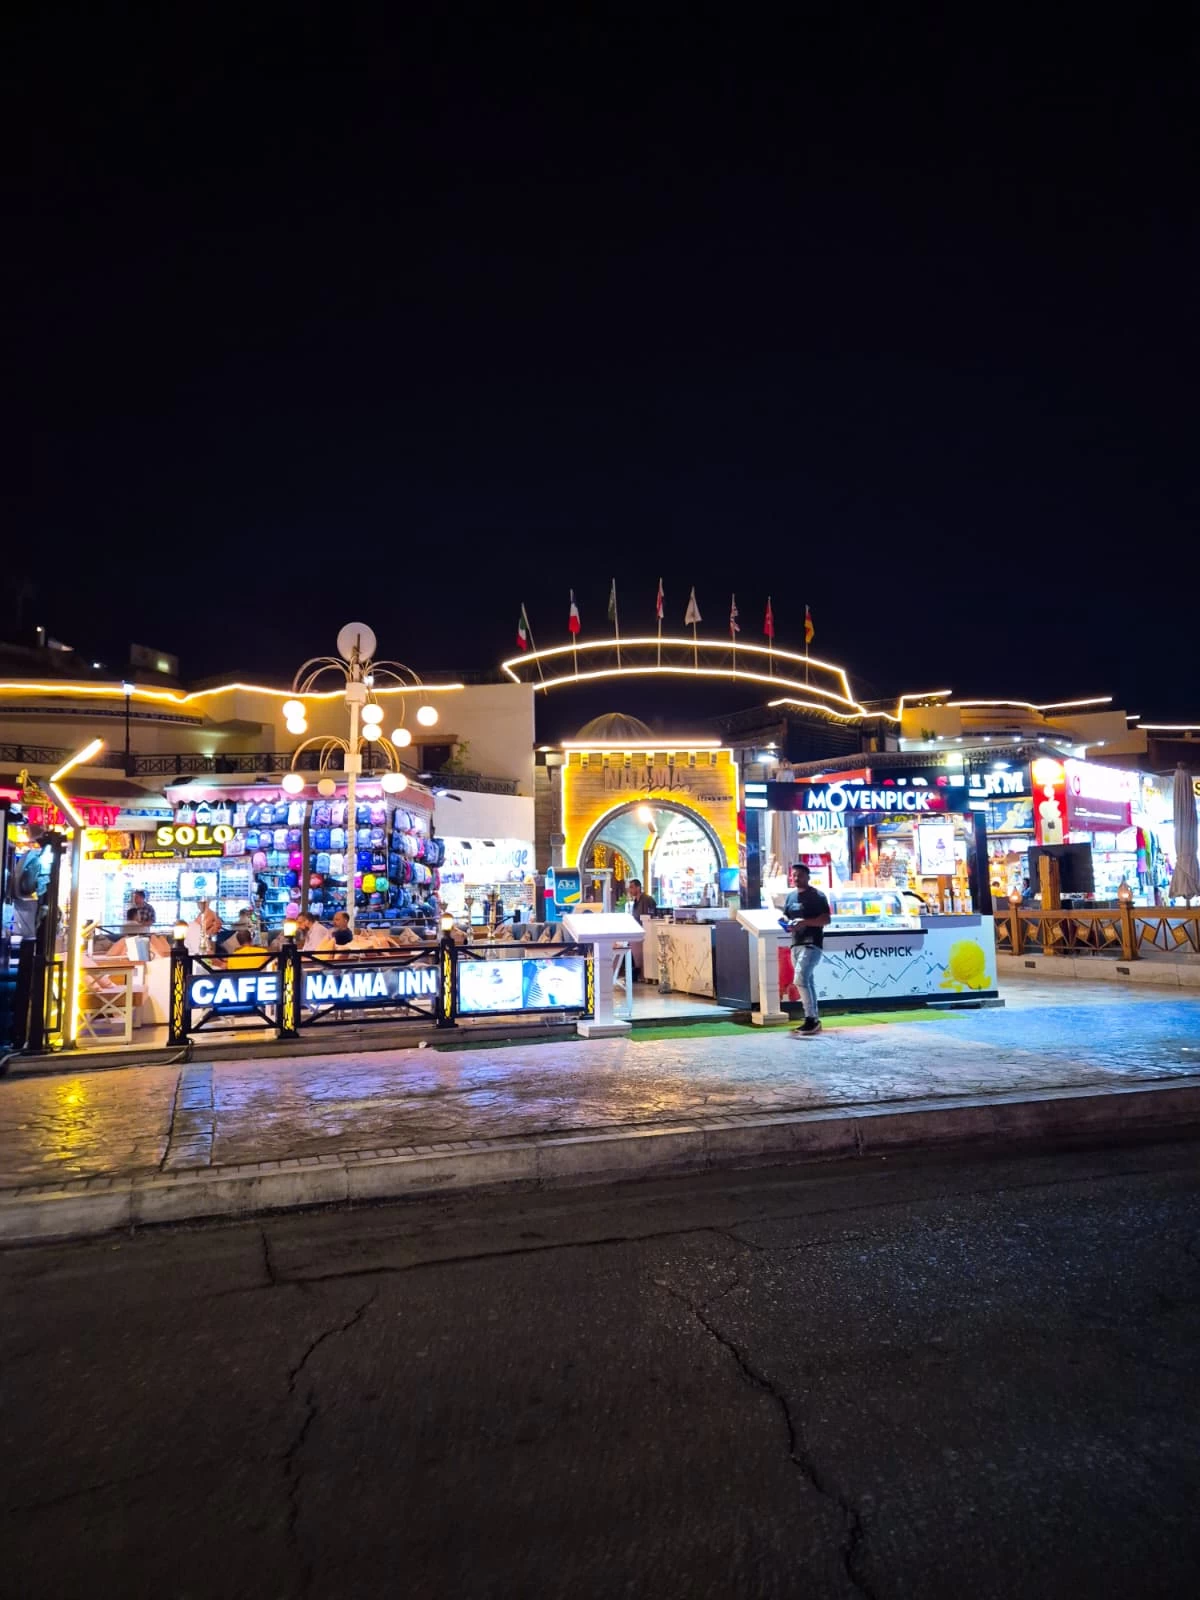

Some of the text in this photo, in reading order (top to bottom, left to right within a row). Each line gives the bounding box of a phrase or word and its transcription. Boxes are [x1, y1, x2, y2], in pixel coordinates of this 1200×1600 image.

[156, 825, 234, 846] SOLO
[191, 976, 277, 1005] CAFE
[306, 969, 437, 1000] NAAMA INN
